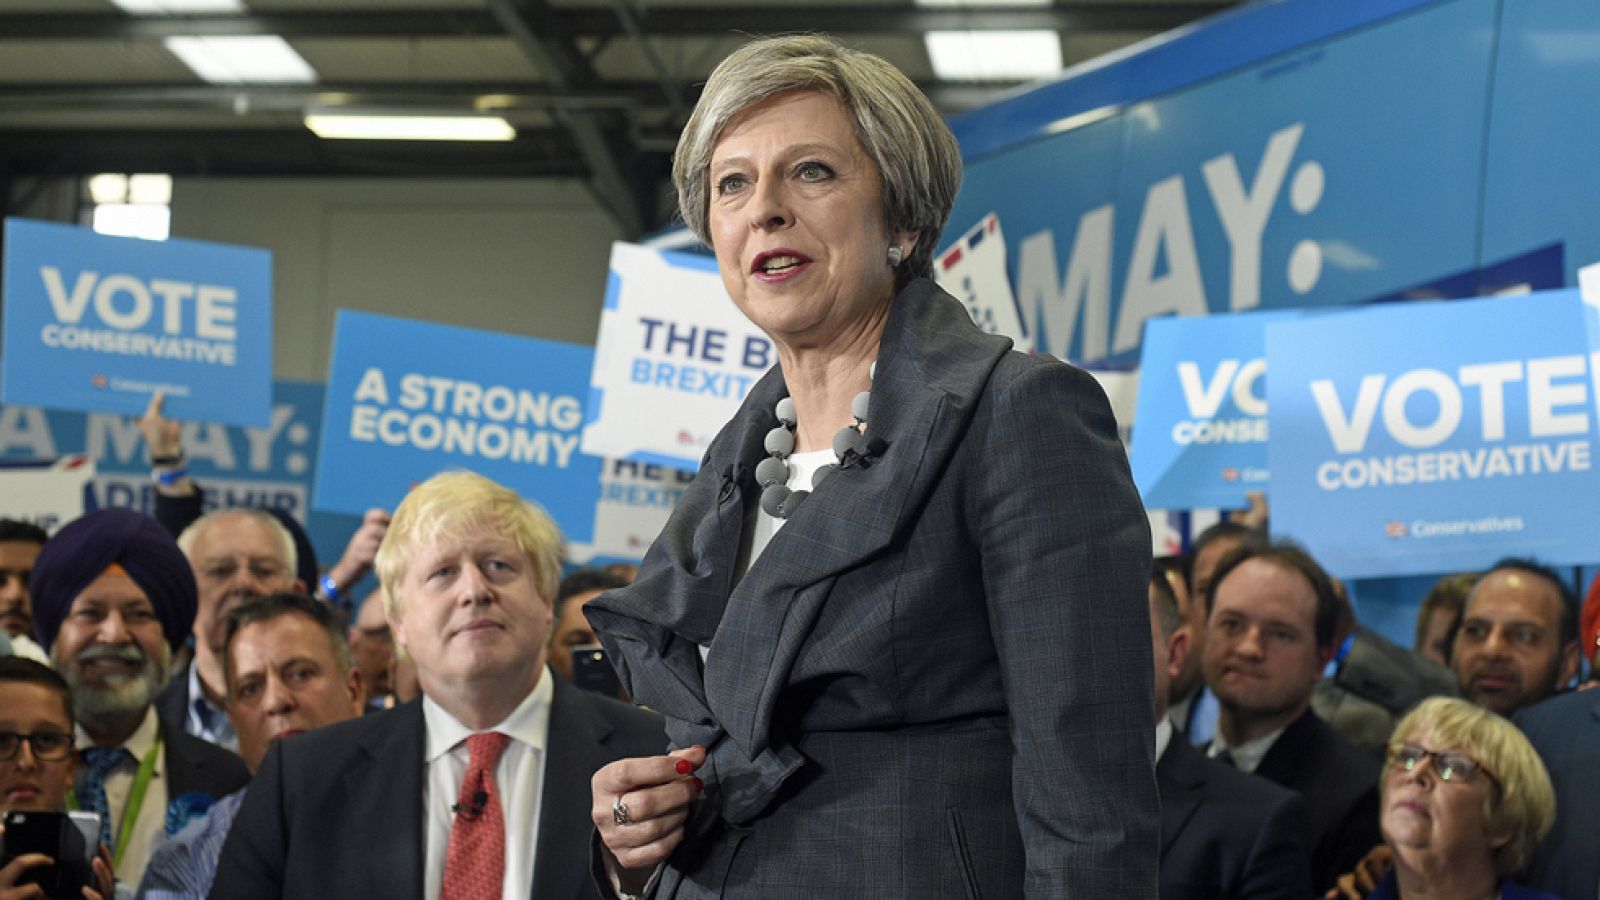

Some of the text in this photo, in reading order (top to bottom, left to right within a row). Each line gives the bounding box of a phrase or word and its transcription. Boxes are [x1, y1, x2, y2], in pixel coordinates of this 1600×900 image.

[1017, 122, 1325, 361] MAY:
[39, 265, 238, 341] VOTE
[41, 324, 236, 366] CONSERVATIVE
[638, 315, 728, 364] THE
[354, 367, 582, 432] A STRONG
[630, 357, 752, 400] BREXIT
[1308, 354, 1590, 454] VOTE
[351, 404, 579, 469] ECONOMY
[1316, 440, 1592, 491] CONSERVATIVE
[1411, 515, 1524, 538] Conservatives
